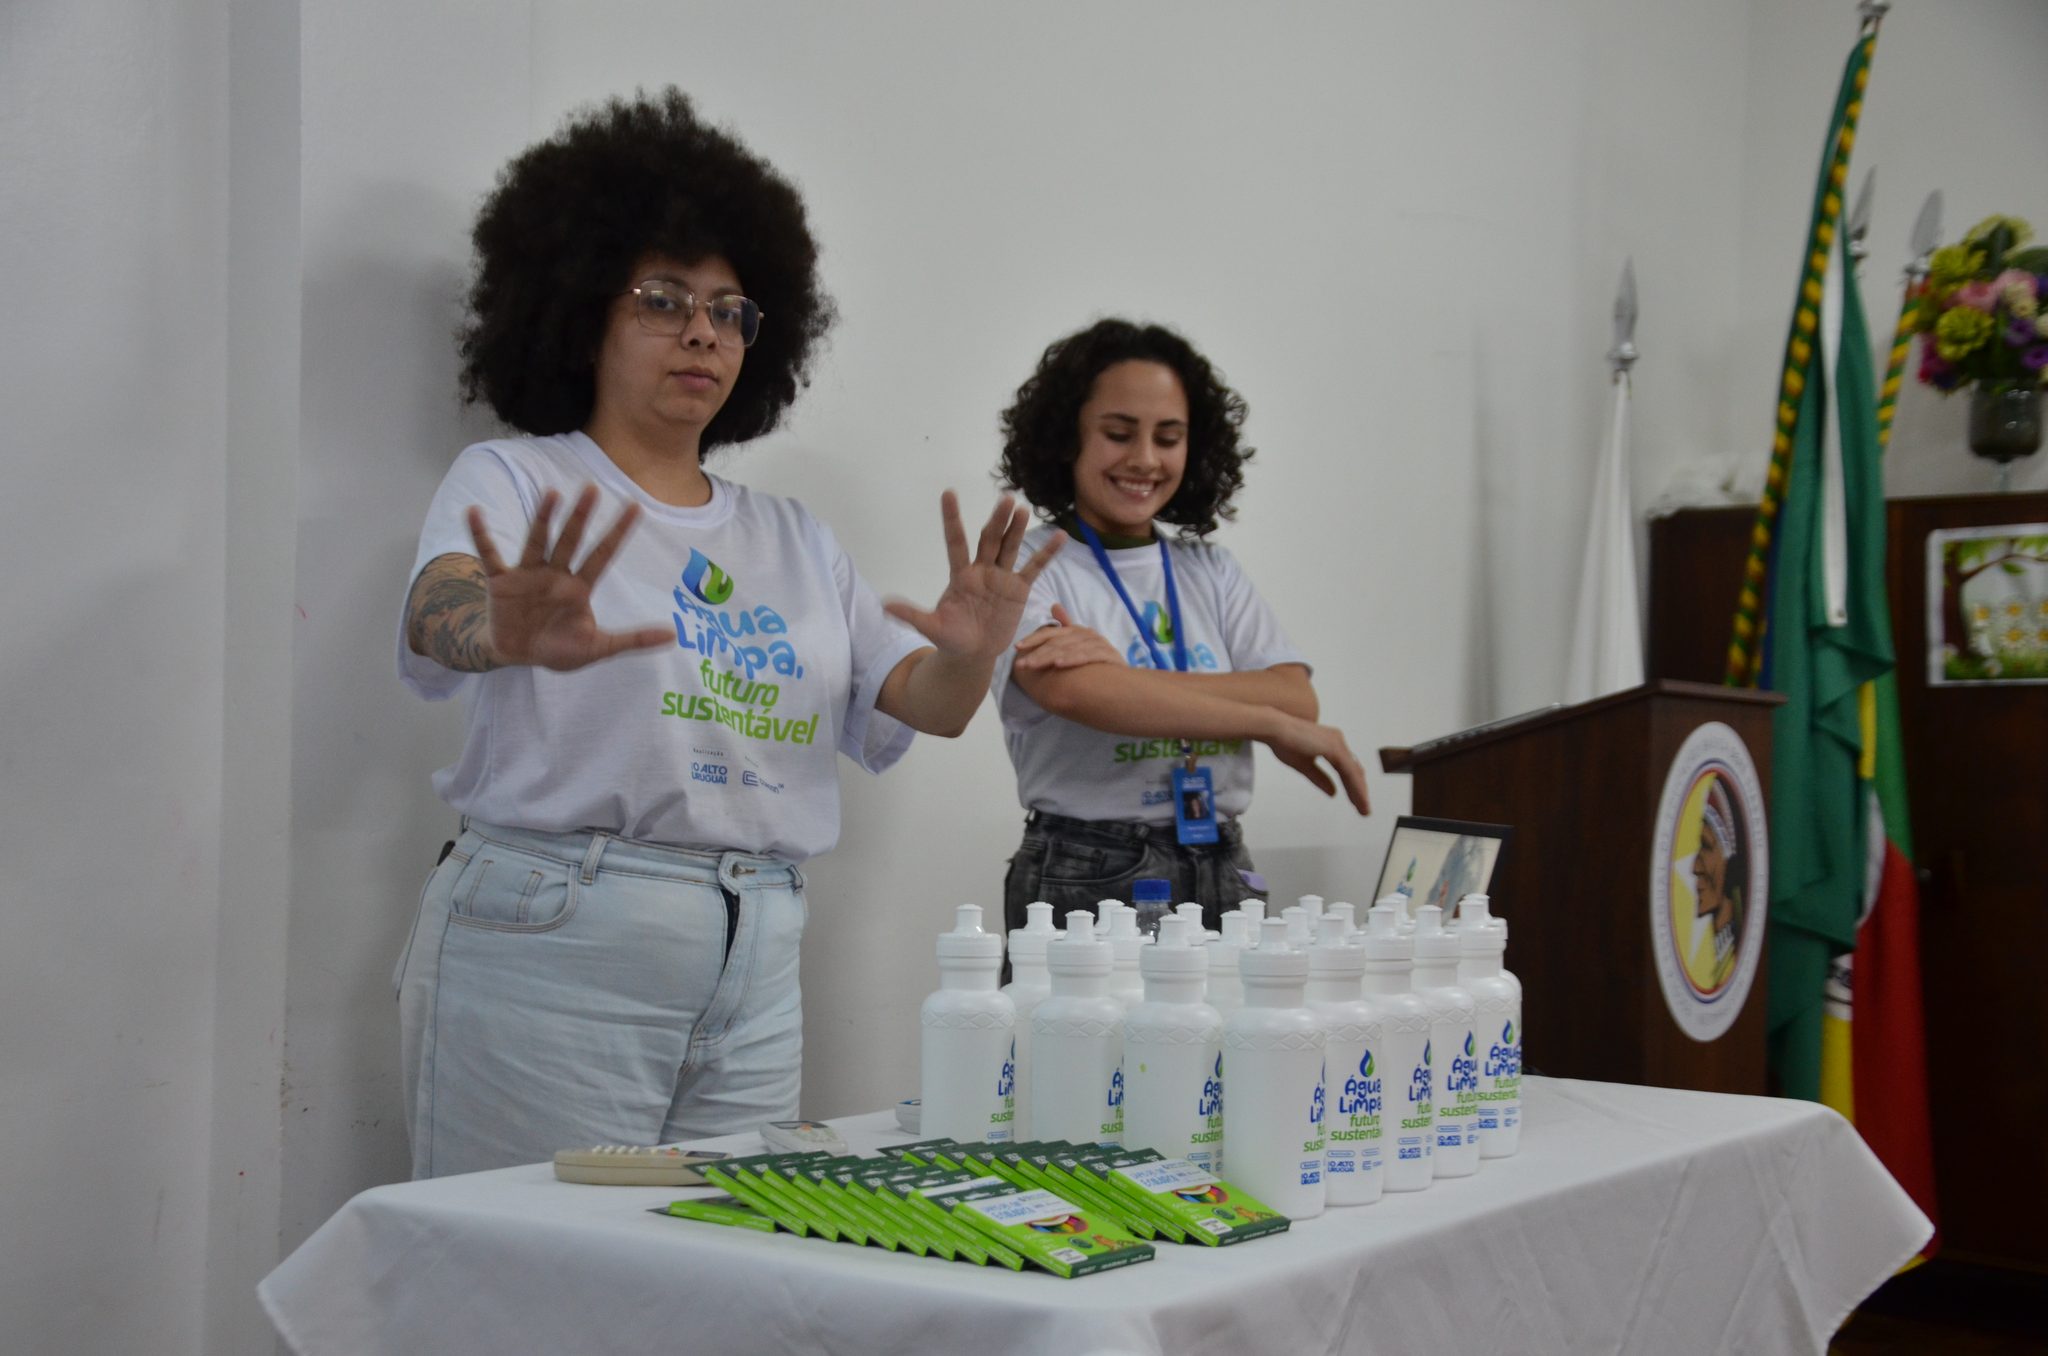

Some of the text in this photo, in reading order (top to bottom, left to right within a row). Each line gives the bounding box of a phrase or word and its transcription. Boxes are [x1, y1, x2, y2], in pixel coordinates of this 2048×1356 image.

[673, 611, 804, 680] Limpa,
[700, 658, 780, 708] futuro
[661, 691, 820, 745] sustentável
[701, 764, 728, 775] ALTO
[1448, 1075, 1477, 1093] Limp
